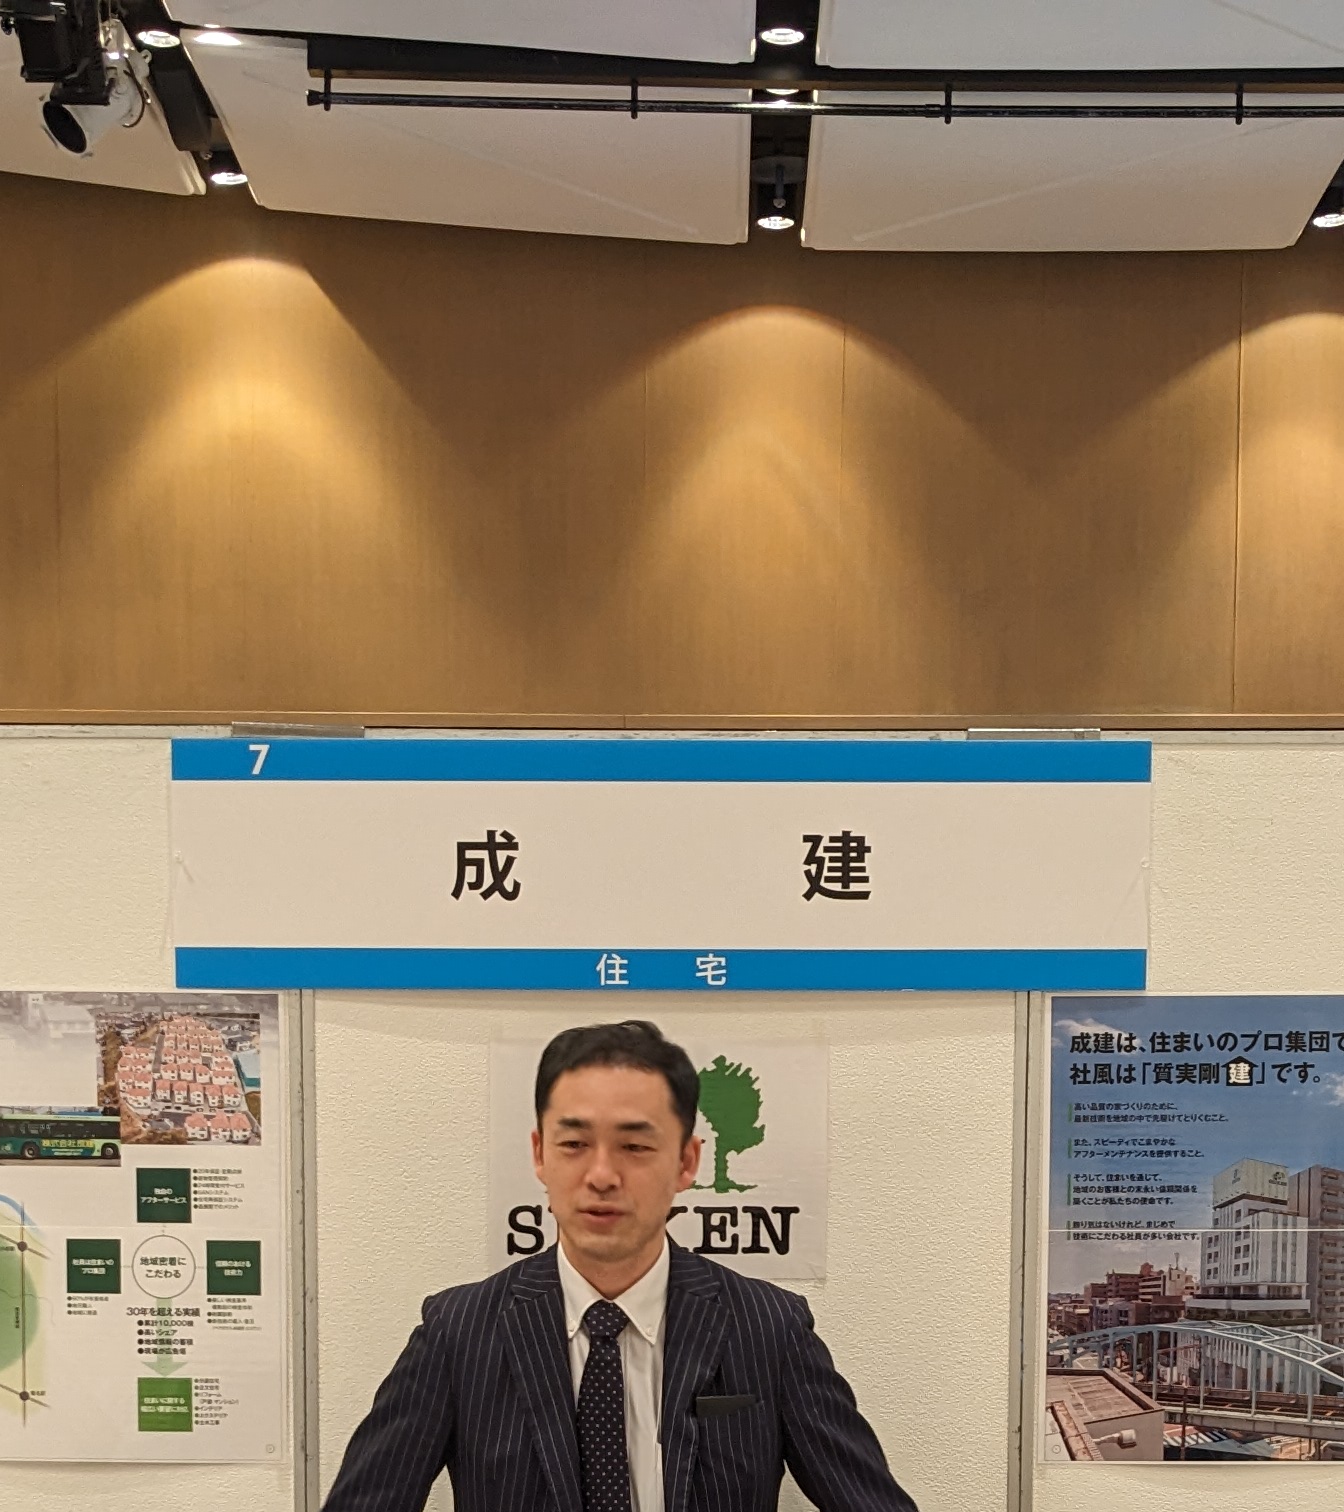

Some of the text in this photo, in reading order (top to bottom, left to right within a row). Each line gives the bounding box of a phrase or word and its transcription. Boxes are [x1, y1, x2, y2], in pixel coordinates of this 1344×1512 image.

[248, 744, 270, 775] 7
[1069, 1059, 1321, 1086] 社風は「質実剛建」です。
[140, 1256, 187, 1266] 地域密着に
[145, 1269, 182, 1279] こだわる
[126, 1307, 200, 1316] 30年を超える実績
